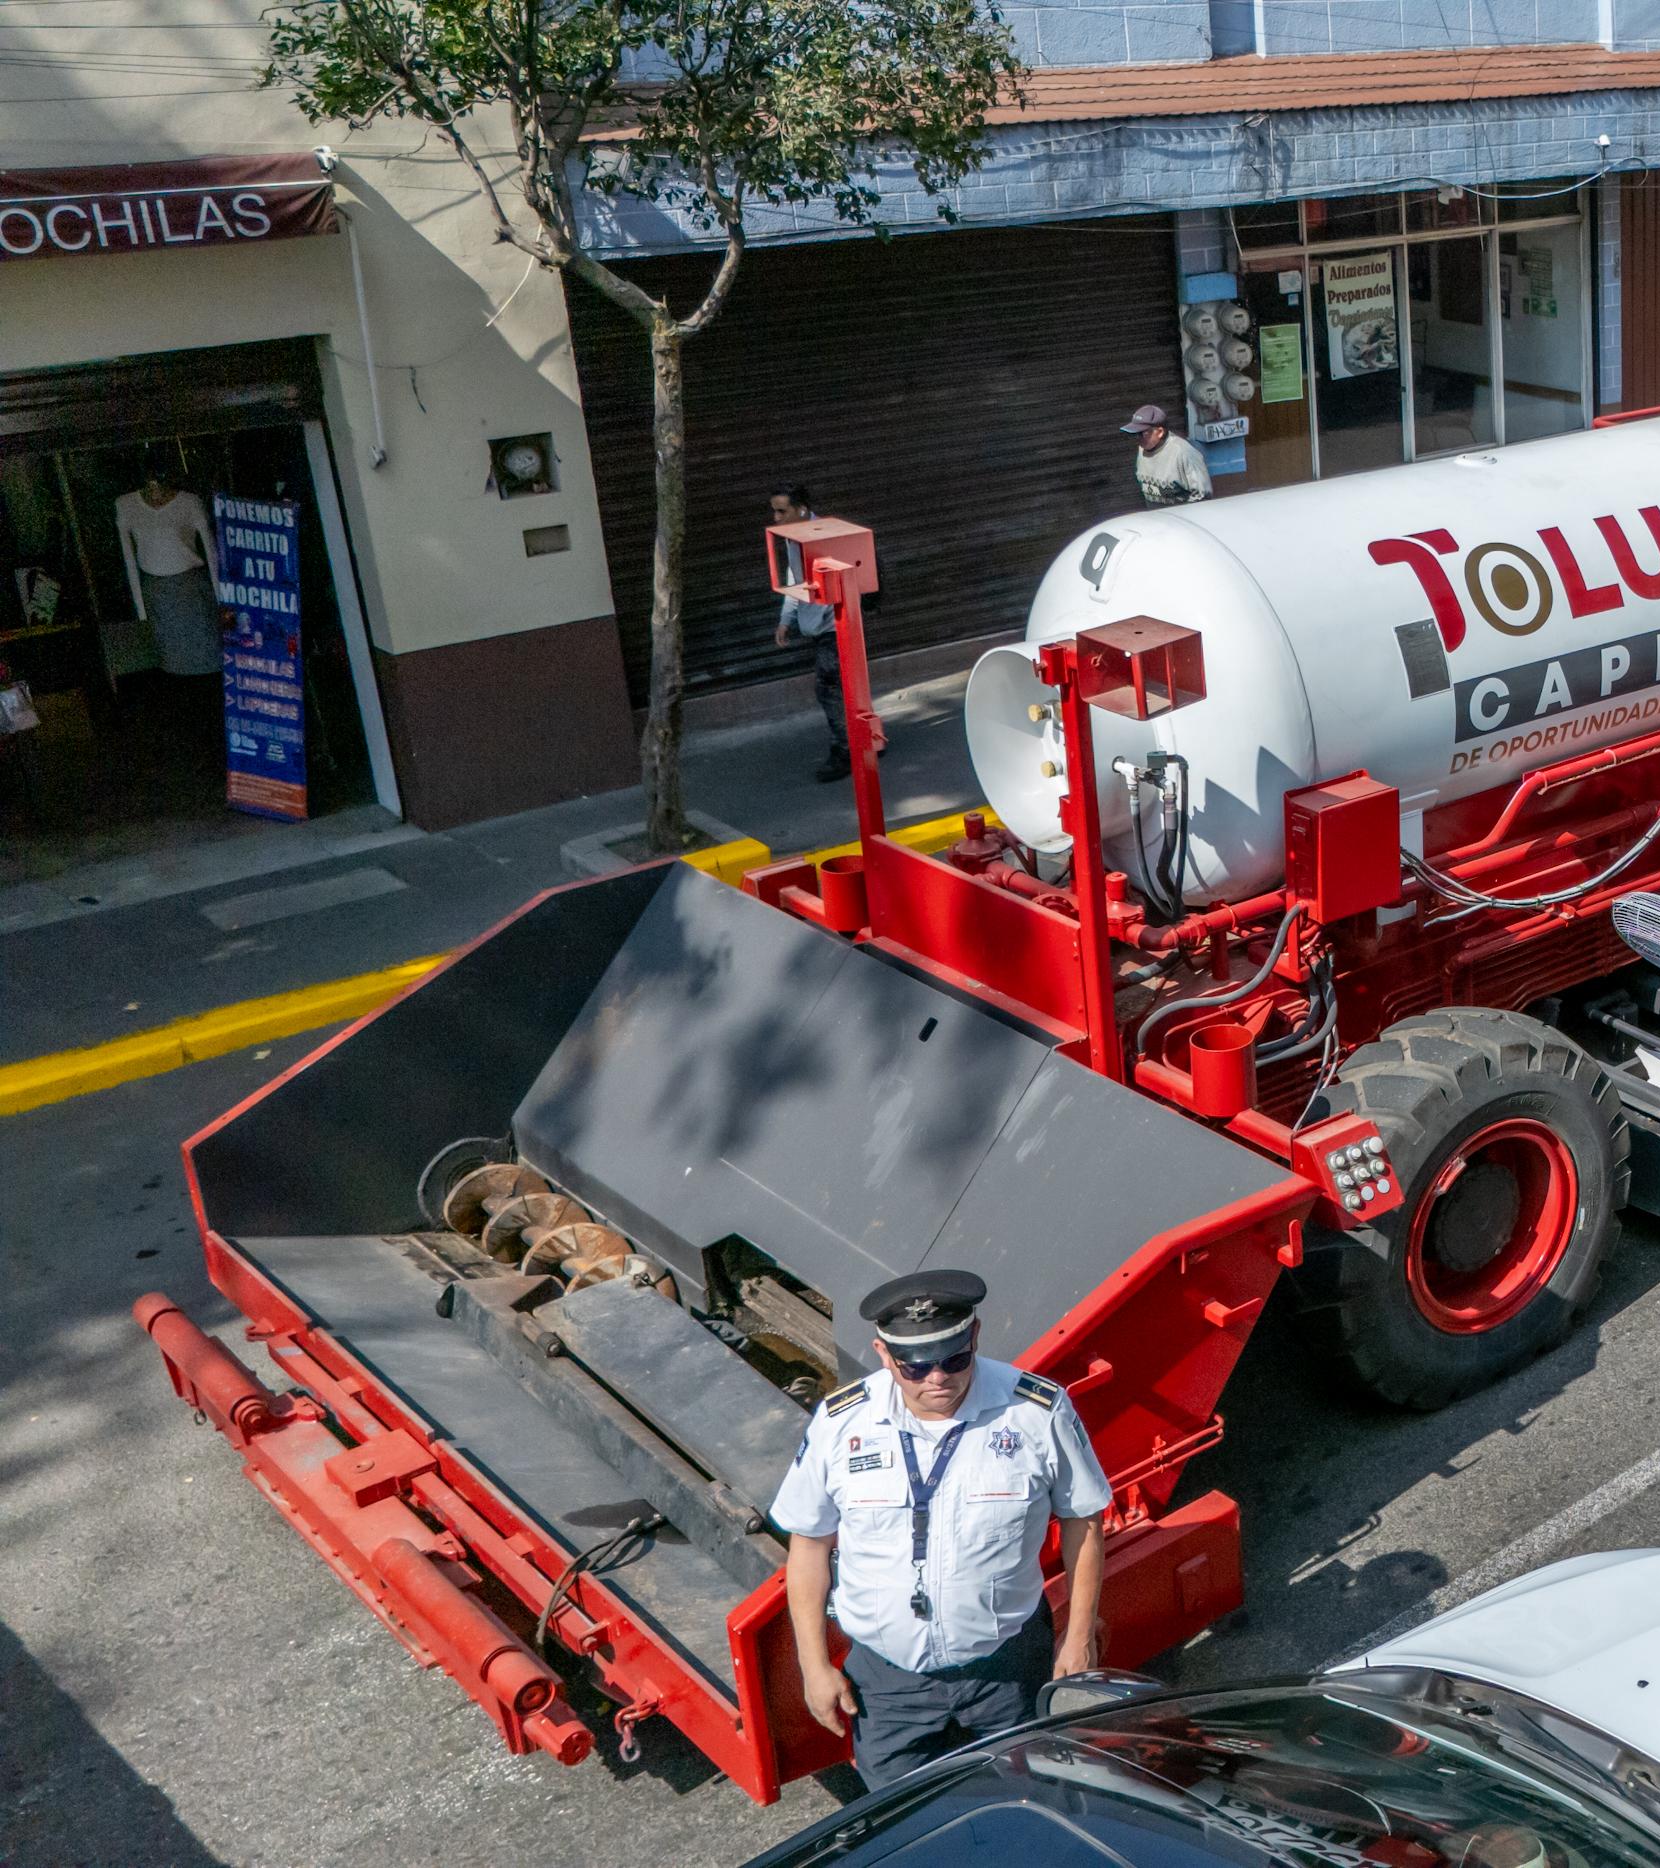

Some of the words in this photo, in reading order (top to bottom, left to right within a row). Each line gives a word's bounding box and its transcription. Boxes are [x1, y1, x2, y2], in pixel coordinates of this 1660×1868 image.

[1329, 261, 1387, 281] Alimentos
[1327, 283, 1391, 305] Preparados
[214, 497, 294, 528] PONEMOS
[225, 526, 289, 555] CARRITO
[245, 557, 255, 578] A
[256, 559, 275, 581] TU
[217, 581, 299, 615] MOCHILA
[1449, 745, 1484, 775] DE
